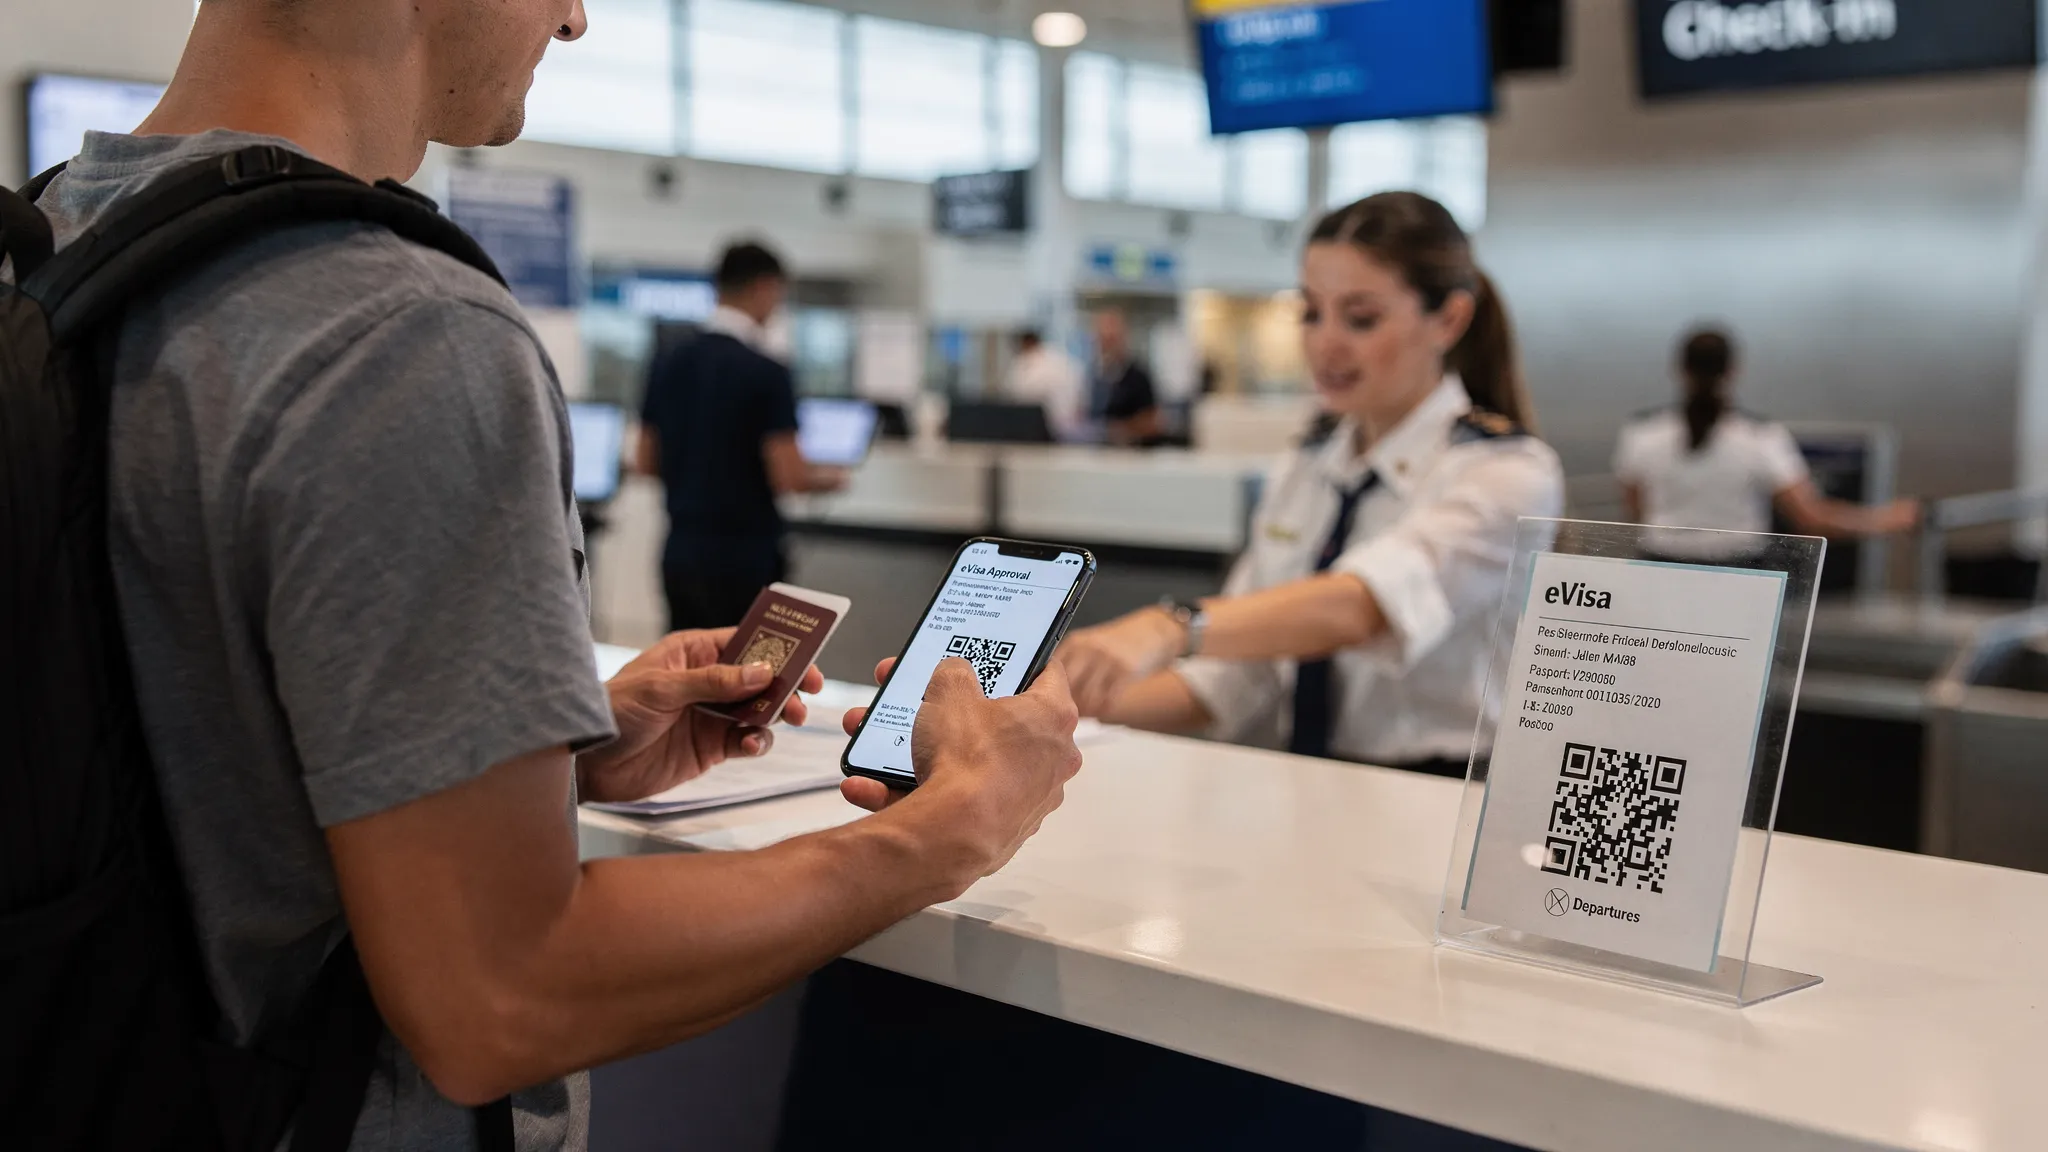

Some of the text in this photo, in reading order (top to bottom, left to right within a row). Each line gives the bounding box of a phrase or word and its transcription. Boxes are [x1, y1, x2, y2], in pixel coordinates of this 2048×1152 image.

[961, 563, 1031, 580] eVisa Approval
[1544, 581, 1612, 610] eVisa
[1529, 664, 1570, 680] Pasport:
[1572, 897, 1641, 923] Departures
